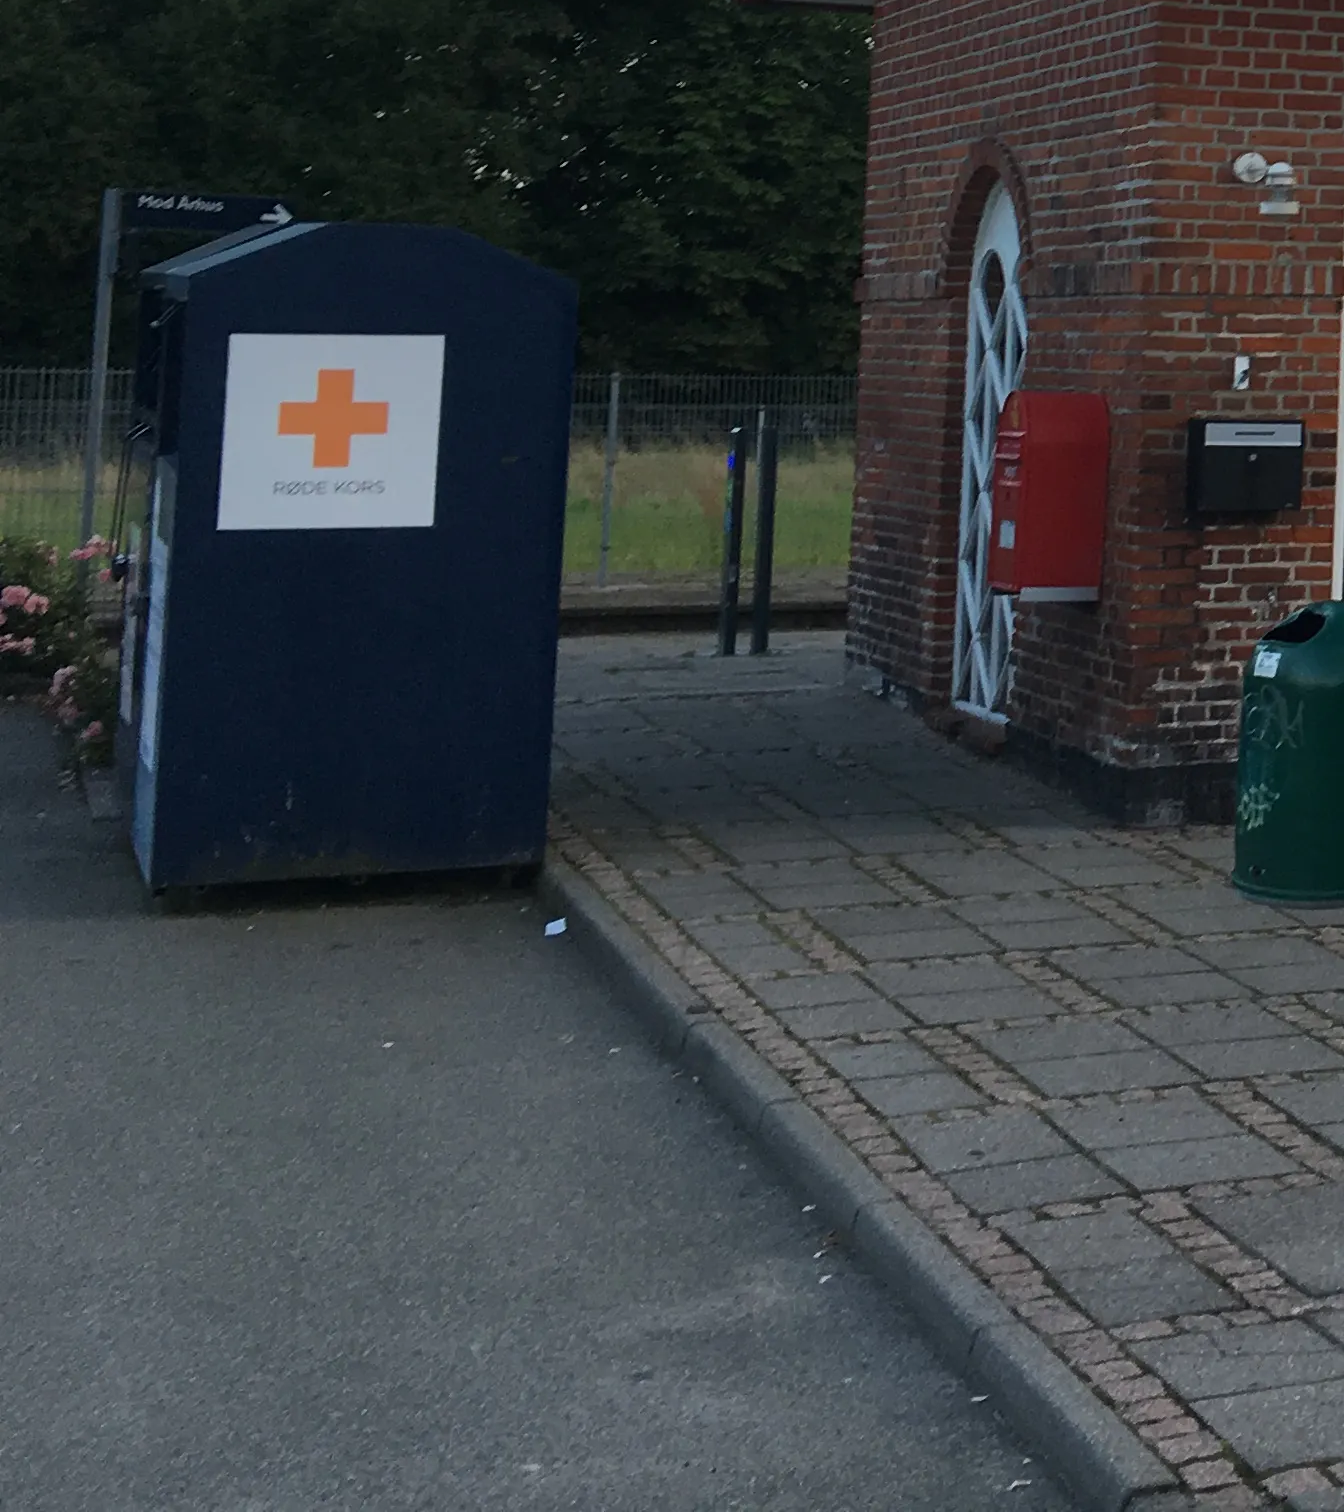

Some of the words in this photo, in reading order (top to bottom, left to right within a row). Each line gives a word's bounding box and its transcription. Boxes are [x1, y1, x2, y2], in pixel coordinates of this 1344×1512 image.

[138, 195, 175, 209] Mod
[273, 480, 328, 496] RØDE
[333, 480, 387, 495] KORS
